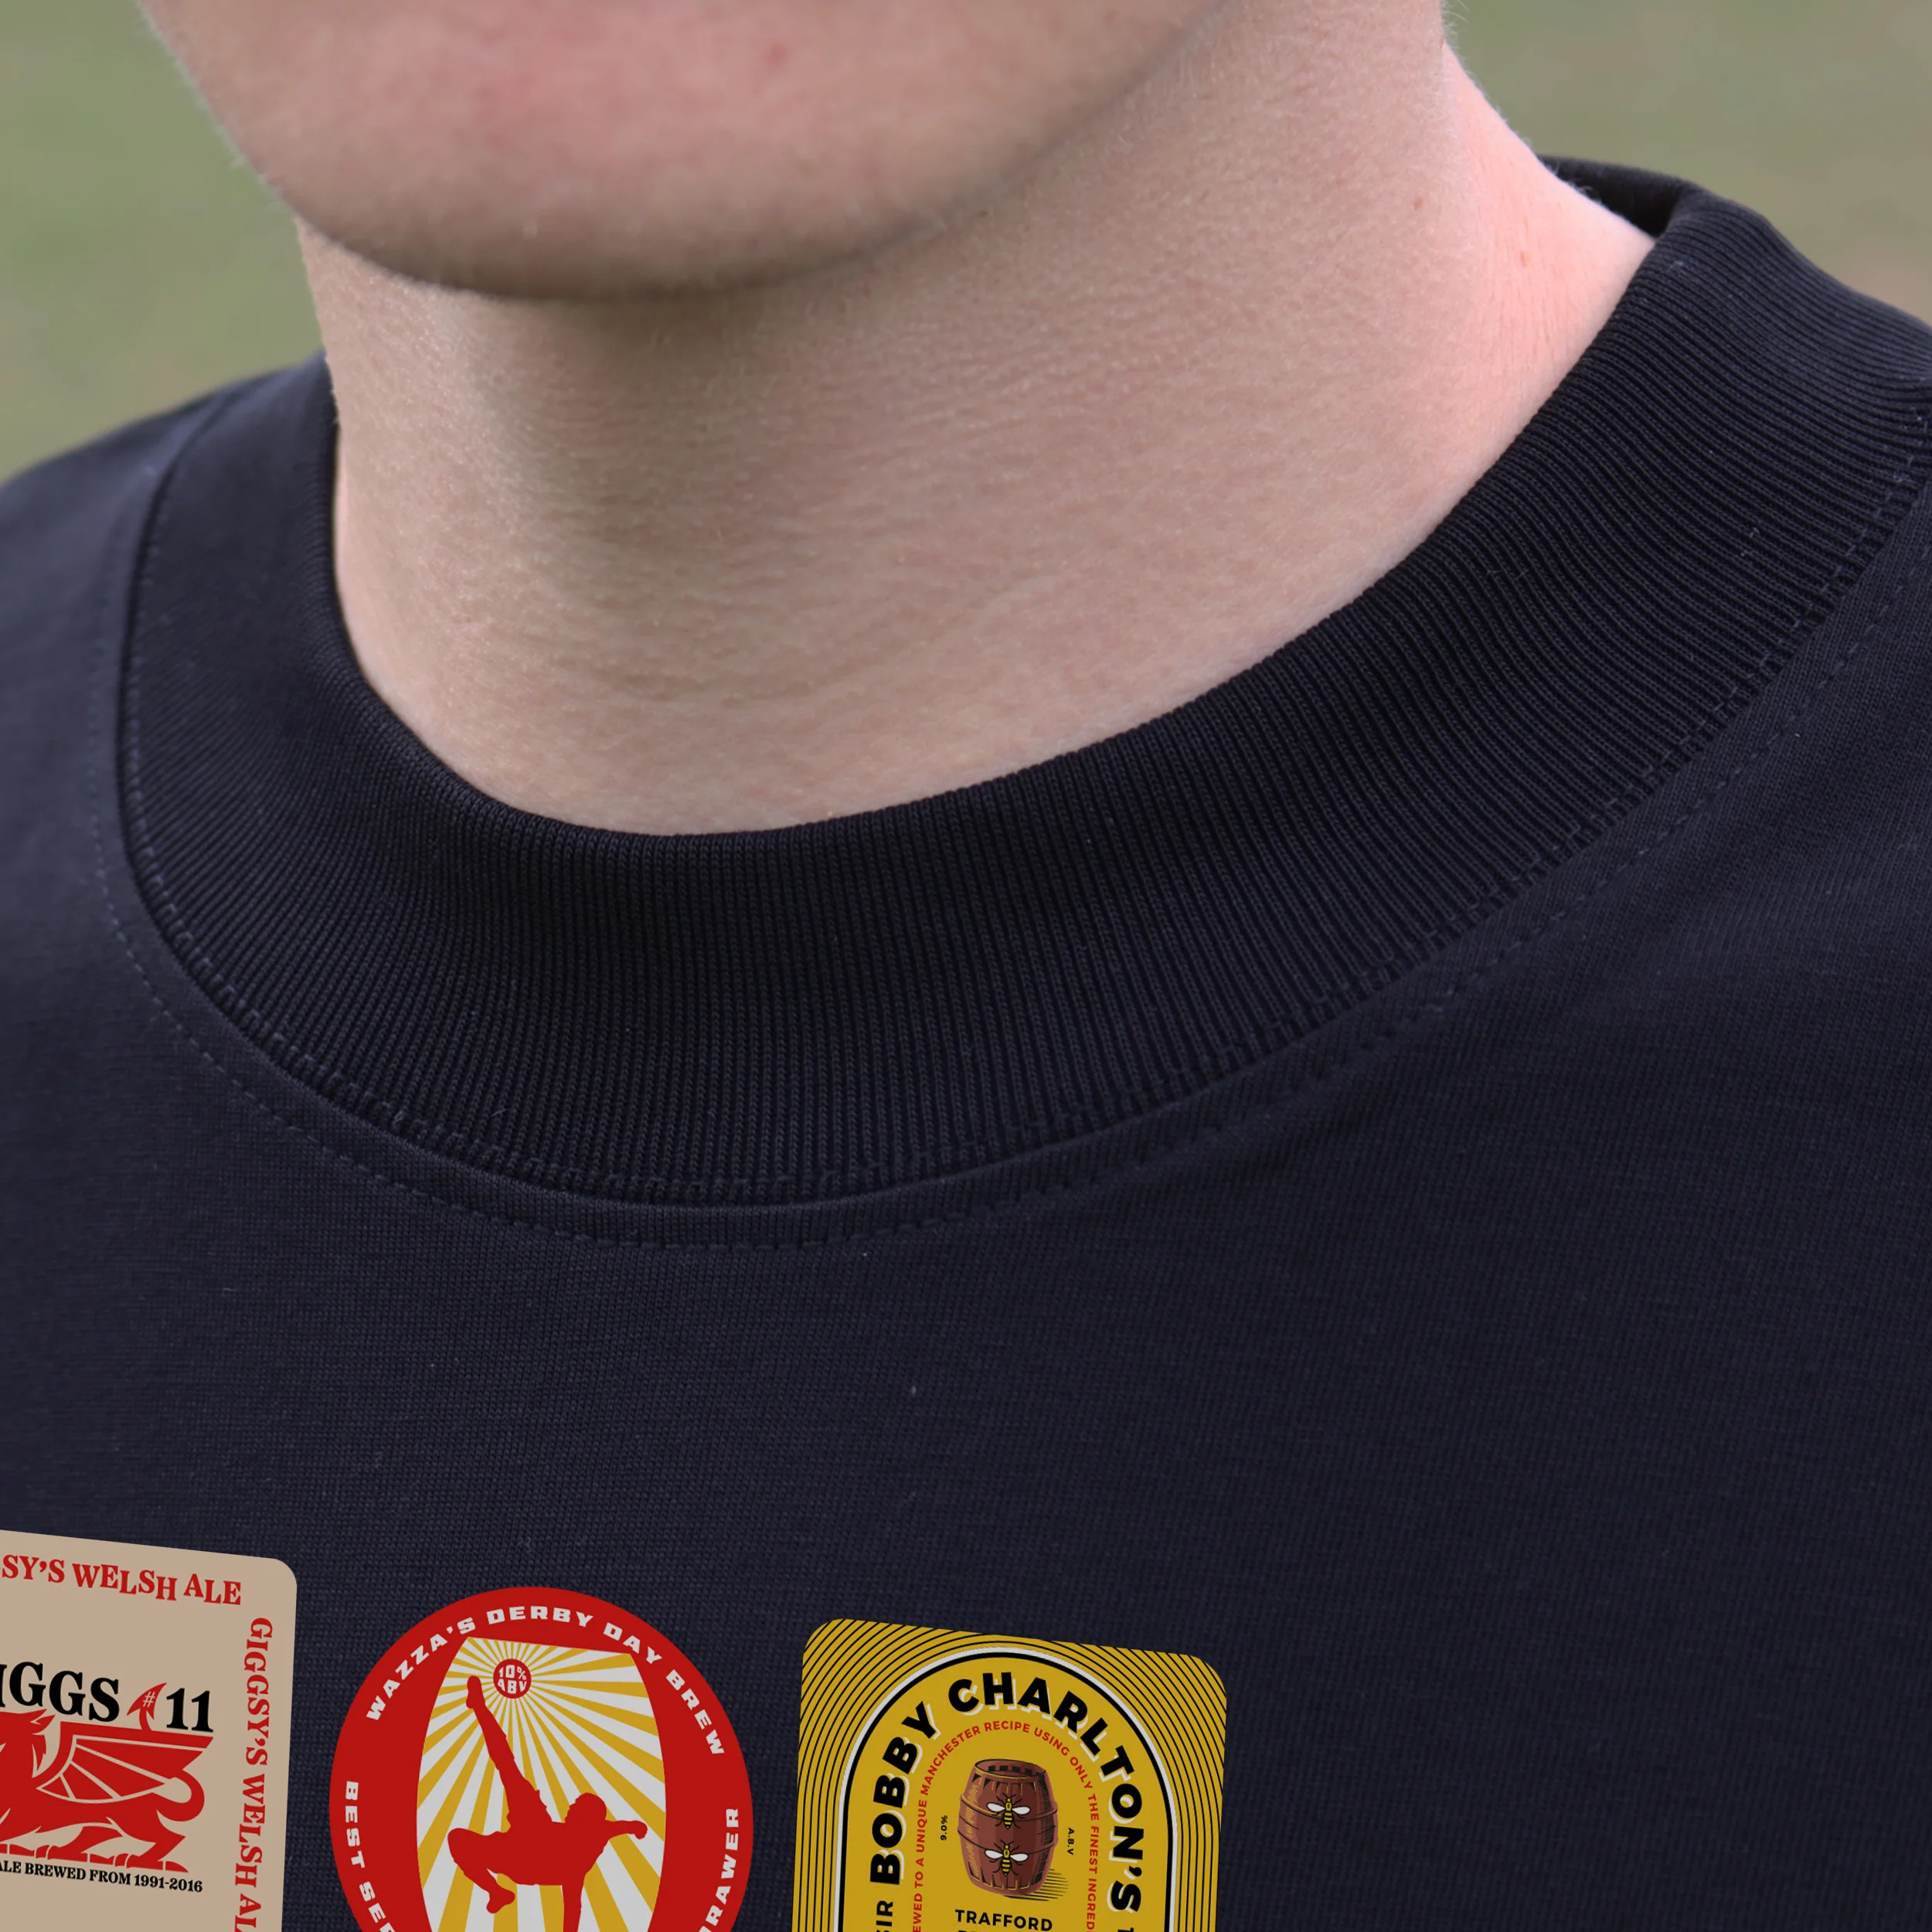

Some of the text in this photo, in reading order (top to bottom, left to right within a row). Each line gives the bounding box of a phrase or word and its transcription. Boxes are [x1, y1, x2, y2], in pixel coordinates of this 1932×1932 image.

[72, 1563, 178, 1601] WELSH
[183, 1573, 241, 1605] ALE
[366, 1606, 724, 1756] WAZZA'S DERBY DAY BREW
[498, 1665, 527, 1680] 10%
[498, 1679, 527, 1694] ABV
[244, 1617, 273, 1766] GIGGSY'S
[984, 1720, 1030, 1733] RECIPE
[1034, 1727, 1070, 1757] USING
[920, 1726, 981, 1795] MANCHESTER
[1070, 1757, 1093, 1790] ONLY
[869, 1672, 1145, 1932] IR BOBBY CHARLTON'S
[1087, 1793, 1100, 1821] THE
[235, 1773, 267, 1888] WELSH
[345, 1781, 366, 1869] BEST
[917, 1800, 927, 1853] UNIQUE
[916, 1857, 925, 1867] A
[1089, 1825, 1100, 1874] FINEST
[25, 1862, 87, 1880] BREWED
[89, 1869, 131, 1886] FROM
[134, 1874, 202, 1893] 1991-2016
[915, 1871, 923, 1889] TO
[955, 1910, 1053, 1931] TRAFFORD
[1086, 1878, 1097, 1932] INGRED
